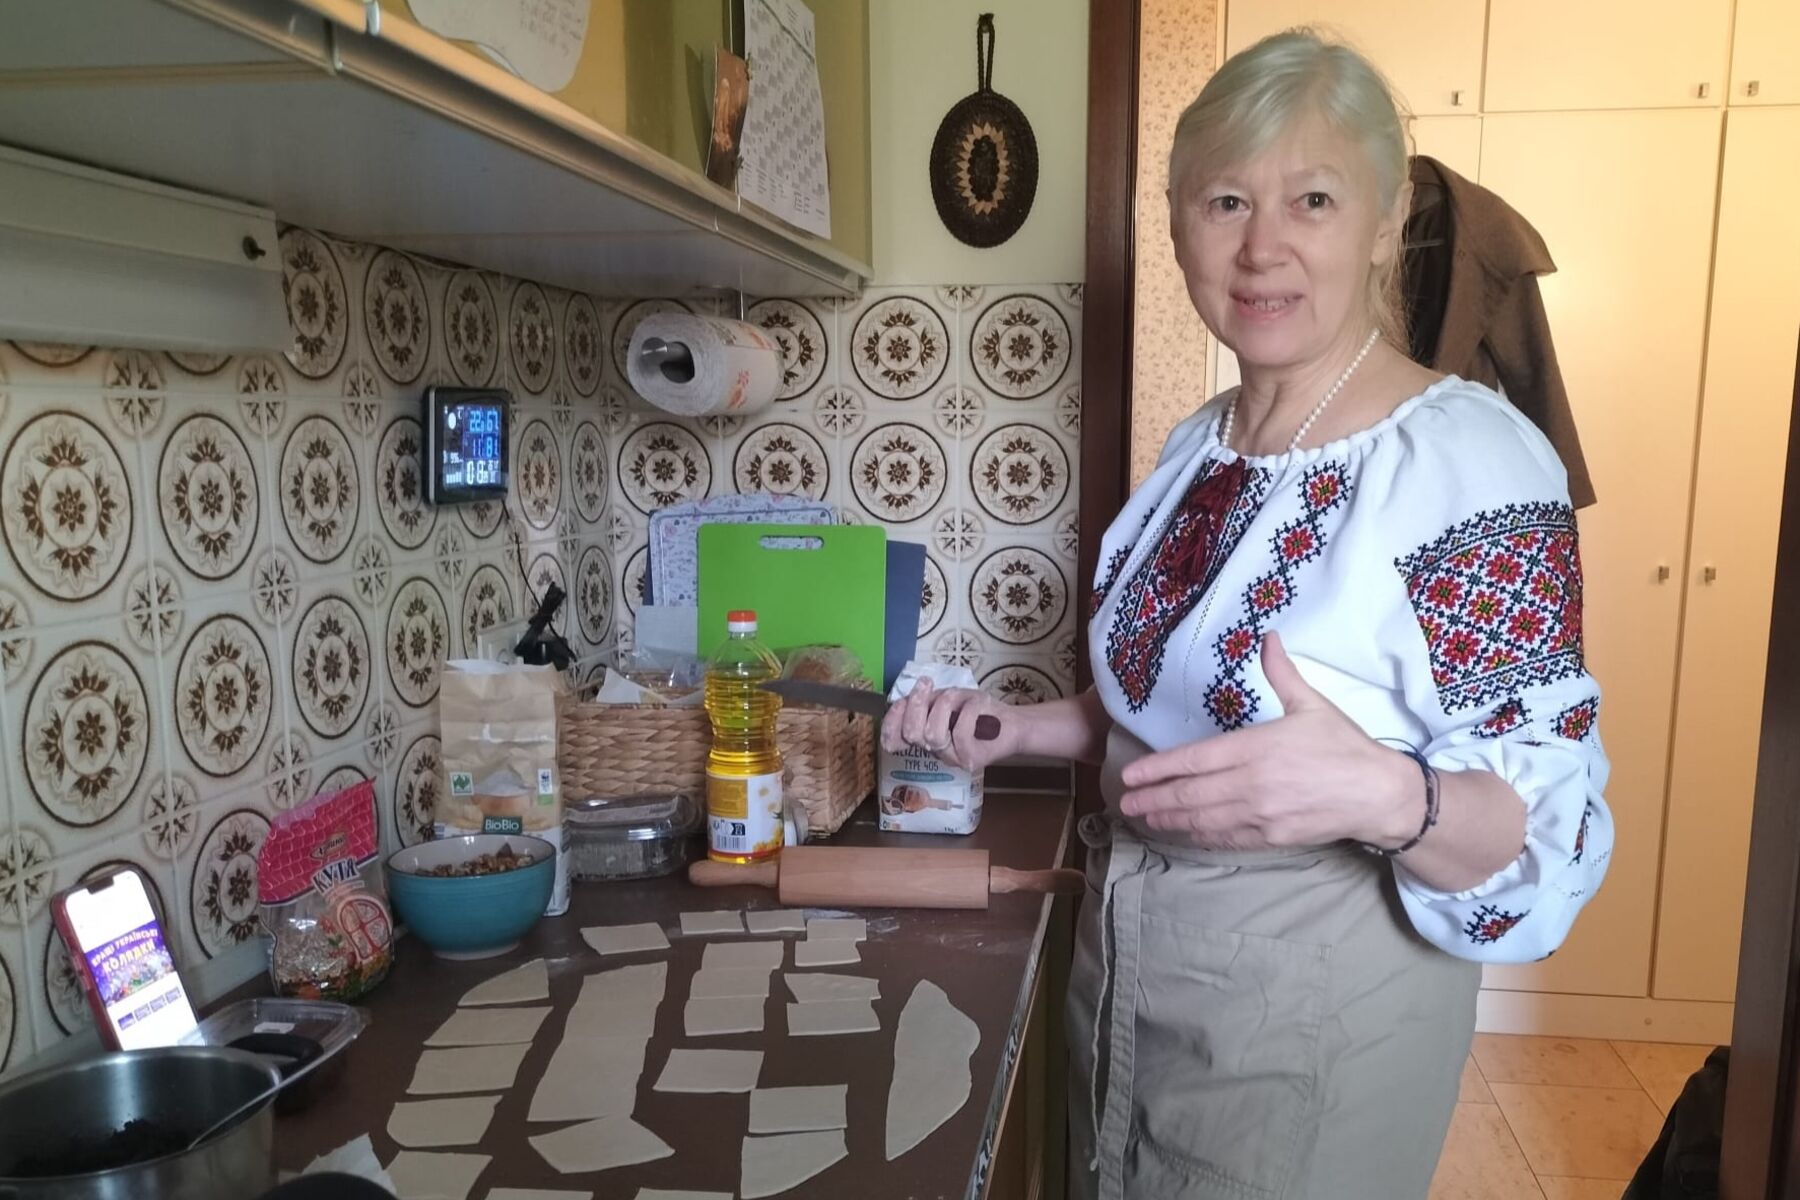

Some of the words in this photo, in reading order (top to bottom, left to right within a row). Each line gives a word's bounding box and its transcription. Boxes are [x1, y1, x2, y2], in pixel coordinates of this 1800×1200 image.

[904, 760, 921, 771] TYPE
[923, 761, 939, 771] 405
[485, 819, 519, 831] BioBio
[102, 938, 156, 973] КОЛЯДКИ
